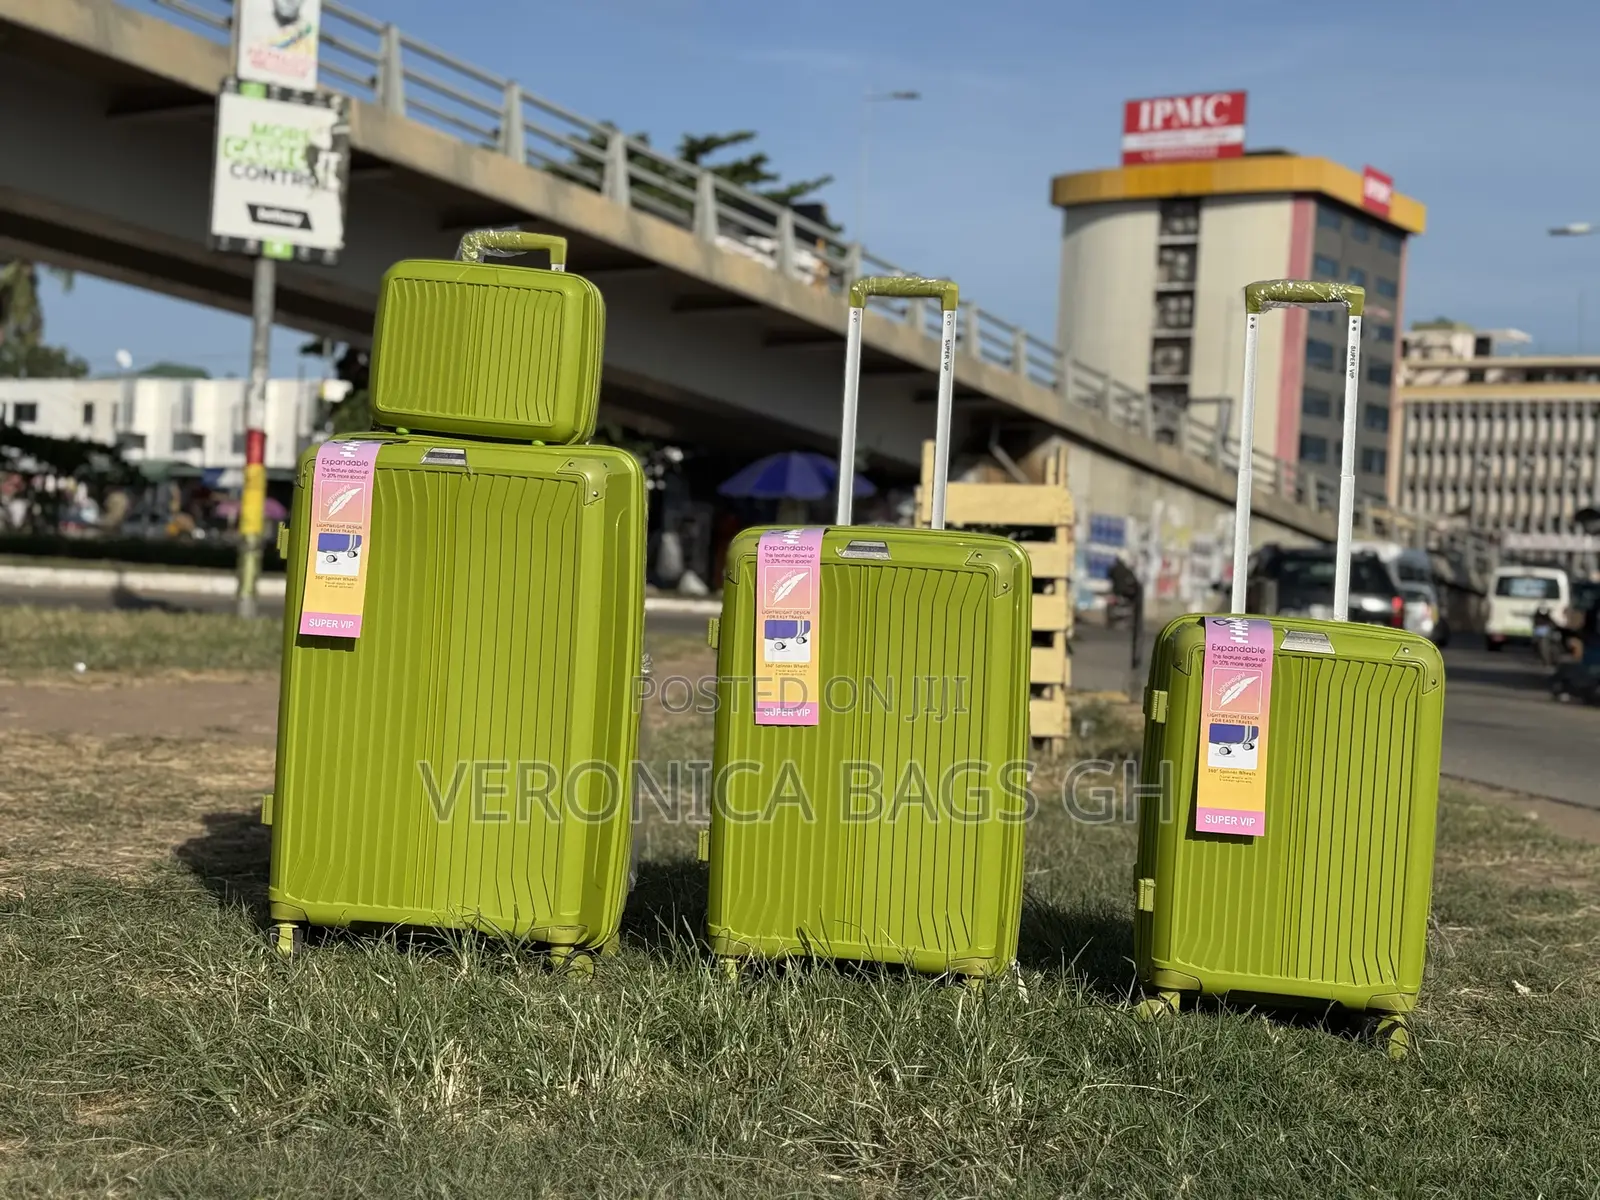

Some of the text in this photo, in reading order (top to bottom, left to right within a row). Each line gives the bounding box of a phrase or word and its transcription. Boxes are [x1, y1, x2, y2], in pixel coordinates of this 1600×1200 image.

[1138, 93, 1232, 131] IPMC
[321, 457, 369, 467] Expandable
[308, 618, 355, 629] SUPER VIP
[1211, 643, 1266, 654] Expandable
[763, 708, 811, 717] SUPER VIP
[1205, 814, 1256, 827] SUPER VIP
